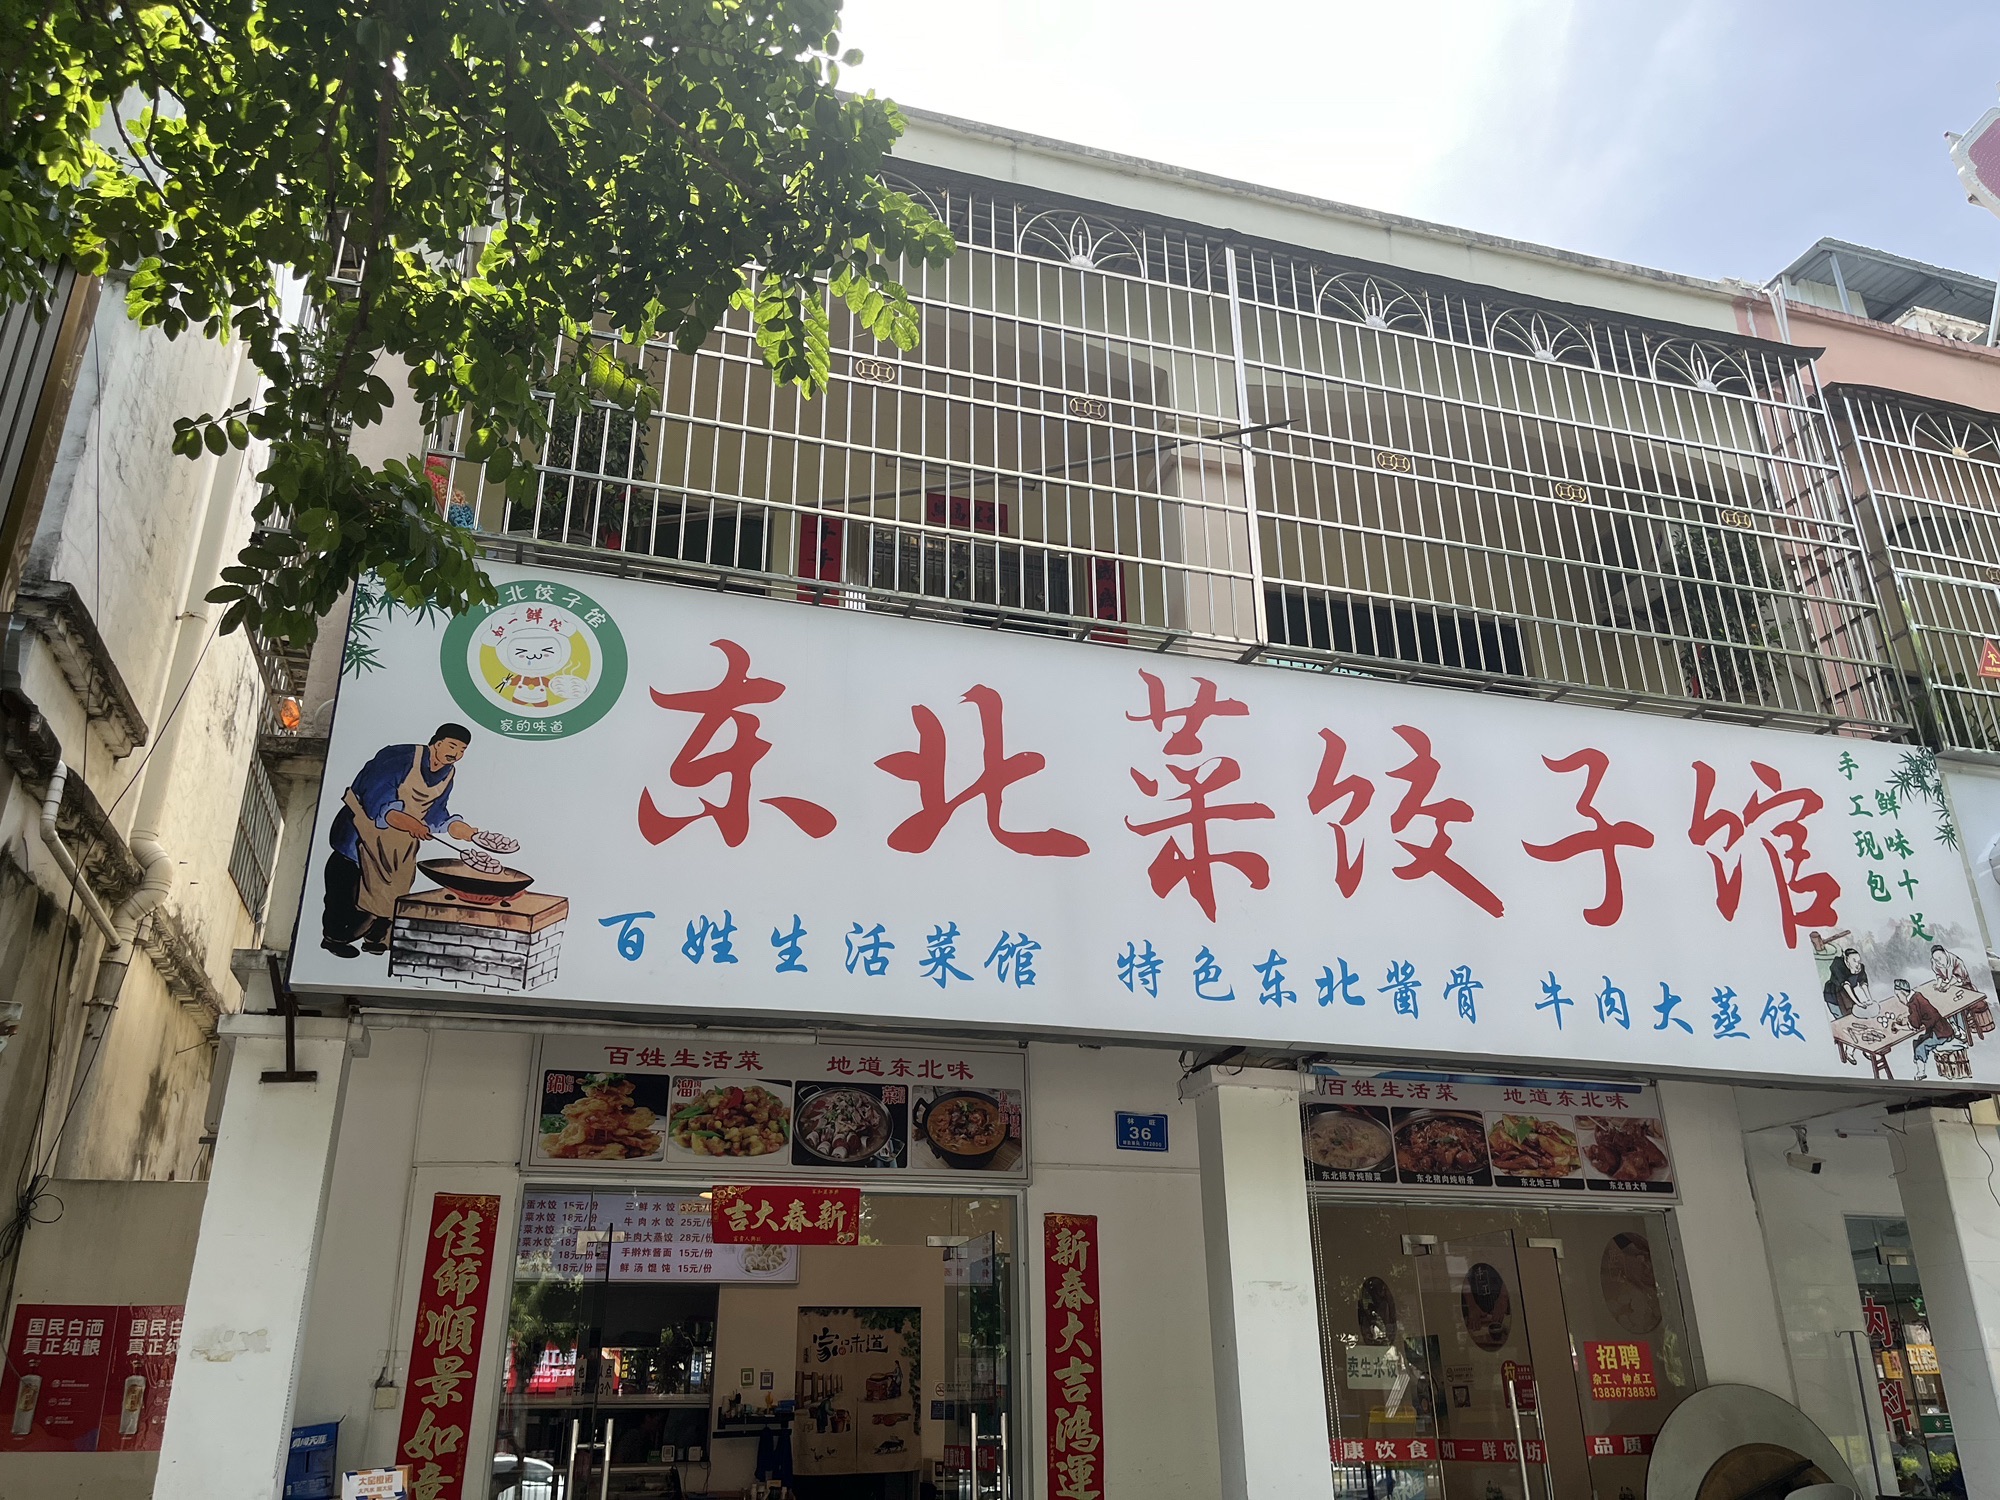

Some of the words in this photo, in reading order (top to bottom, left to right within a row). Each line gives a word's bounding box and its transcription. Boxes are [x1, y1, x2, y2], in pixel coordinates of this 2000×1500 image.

[500, 719, 563, 733] 家的味道
[638, 638, 1842, 949] 东北菜饺子馆
[1838, 751, 1892, 902] 手工现包
[1875, 789, 1934, 942] 鲜味十足
[598, 910, 1042, 989] 百姓生活菜馆
[1535, 971, 1806, 1042] 牛肉大蒸饺
[604, 1046, 764, 1071] 百姓生活菜
[826, 1056, 974, 1080] 地道东北味
[1324, 1078, 1458, 1101] 百姓生活菜
[1503, 1088, 1629, 1110] 地道东北味
[1129, 1126, 1152, 1140] 36
[1321, 1171, 1382, 1182] 东北排骨炖酸菜
[1416, 1173, 1475, 1185] 东北猪肉炖粉条
[1520, 1178, 1560, 1188] 东北地三鲜
[522, 1200, 557, 1210] 蛋水饺
[625, 1202, 675, 1211] 三鲜水饺
[624, 1217, 674, 1227] 牛肉水饺
[680, 1249, 713, 1258] 15元/份
[620, 1263, 671, 1273] 鲜汤馄饨
[678, 1263, 713, 1273] 15元/份
[23, 1338, 101, 1356] 真正纯粮
[1596, 1344, 1641, 1370] 招聘
[1592, 1372, 1652, 1385] 杂工、钟点工
[1593, 1387, 1657, 1398] 13836738836
[1331, 1440, 1429, 1460] 康饮食
[1594, 1437, 1655, 1455] 品质
